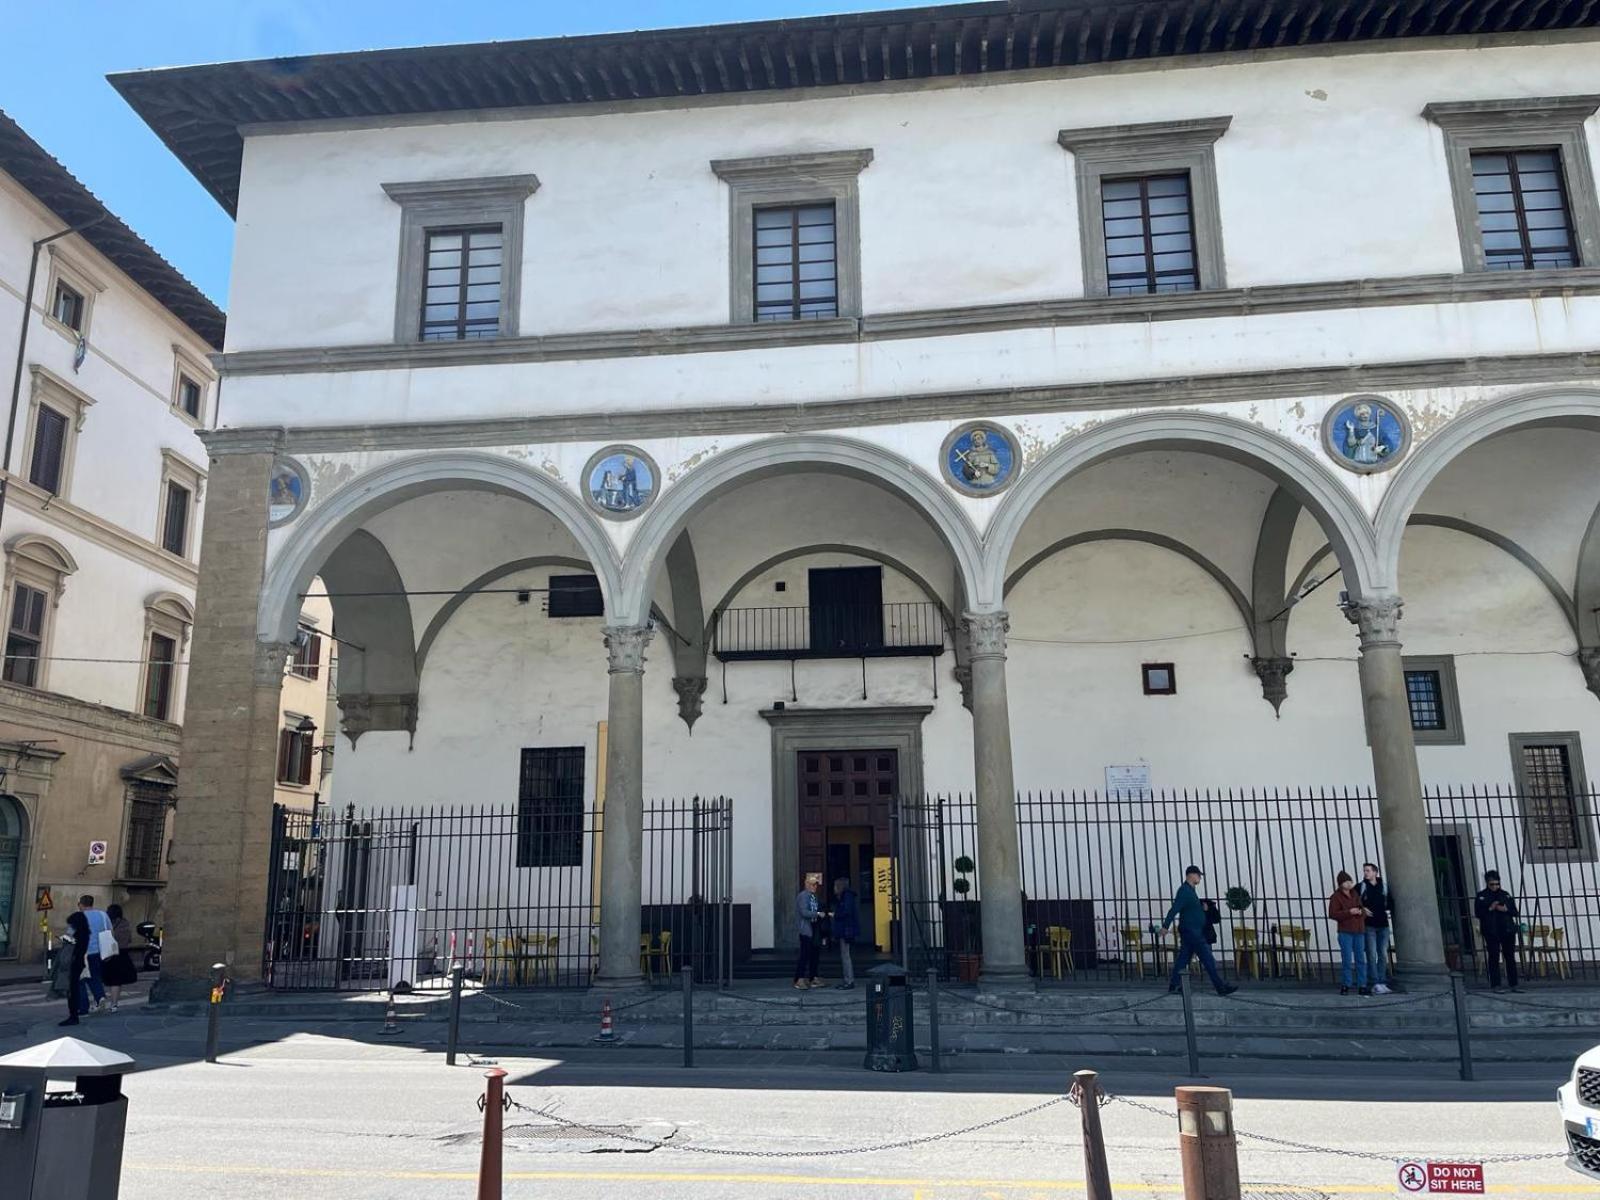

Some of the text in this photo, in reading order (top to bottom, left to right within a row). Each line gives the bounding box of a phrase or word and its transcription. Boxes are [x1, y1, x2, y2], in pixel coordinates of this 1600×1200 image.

[878, 867, 887, 893] RAW
[1433, 1167, 1477, 1178] DO NOT
[1430, 1180, 1482, 1190] SIT HERE
